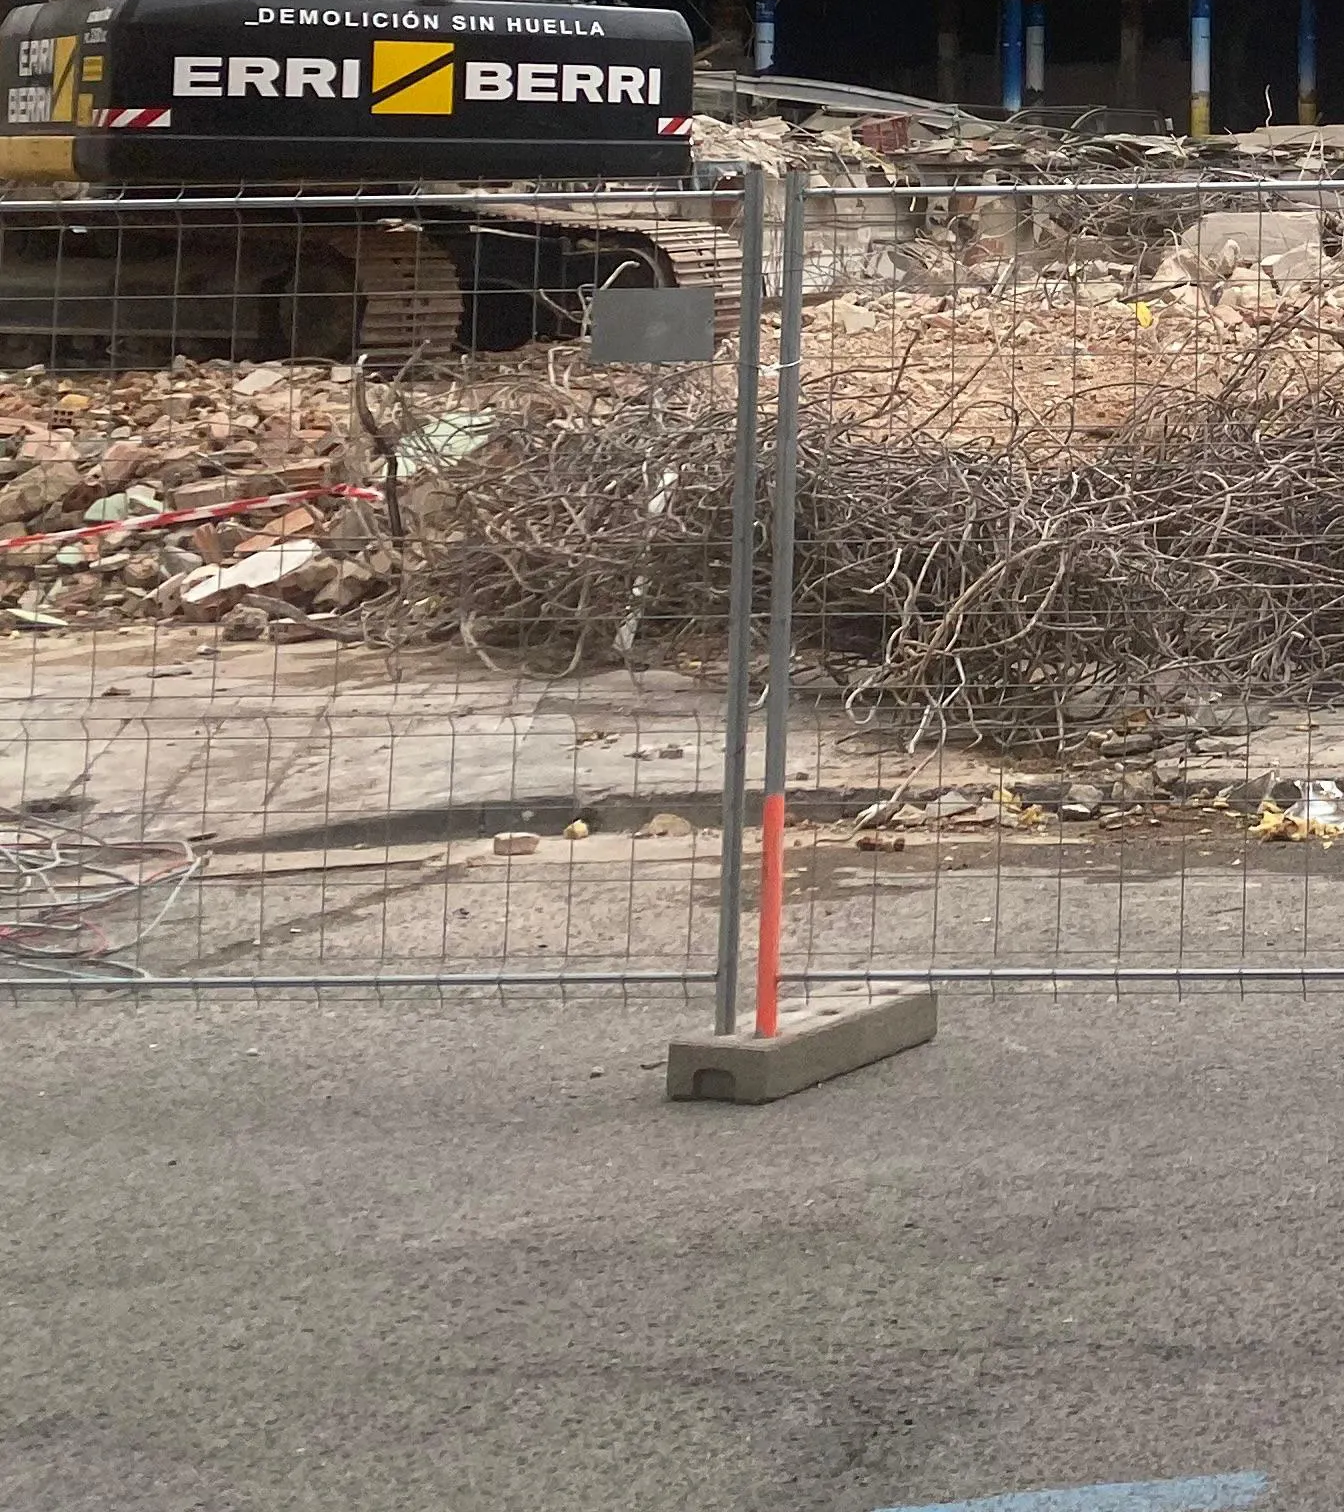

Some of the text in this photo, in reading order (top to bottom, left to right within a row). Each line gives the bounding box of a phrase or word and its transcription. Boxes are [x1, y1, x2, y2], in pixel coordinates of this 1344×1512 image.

[452, 15, 497, 32] SIN
[507, 17, 606, 37] HUELLA
[173, 56, 662, 106] ERRI BERRI
